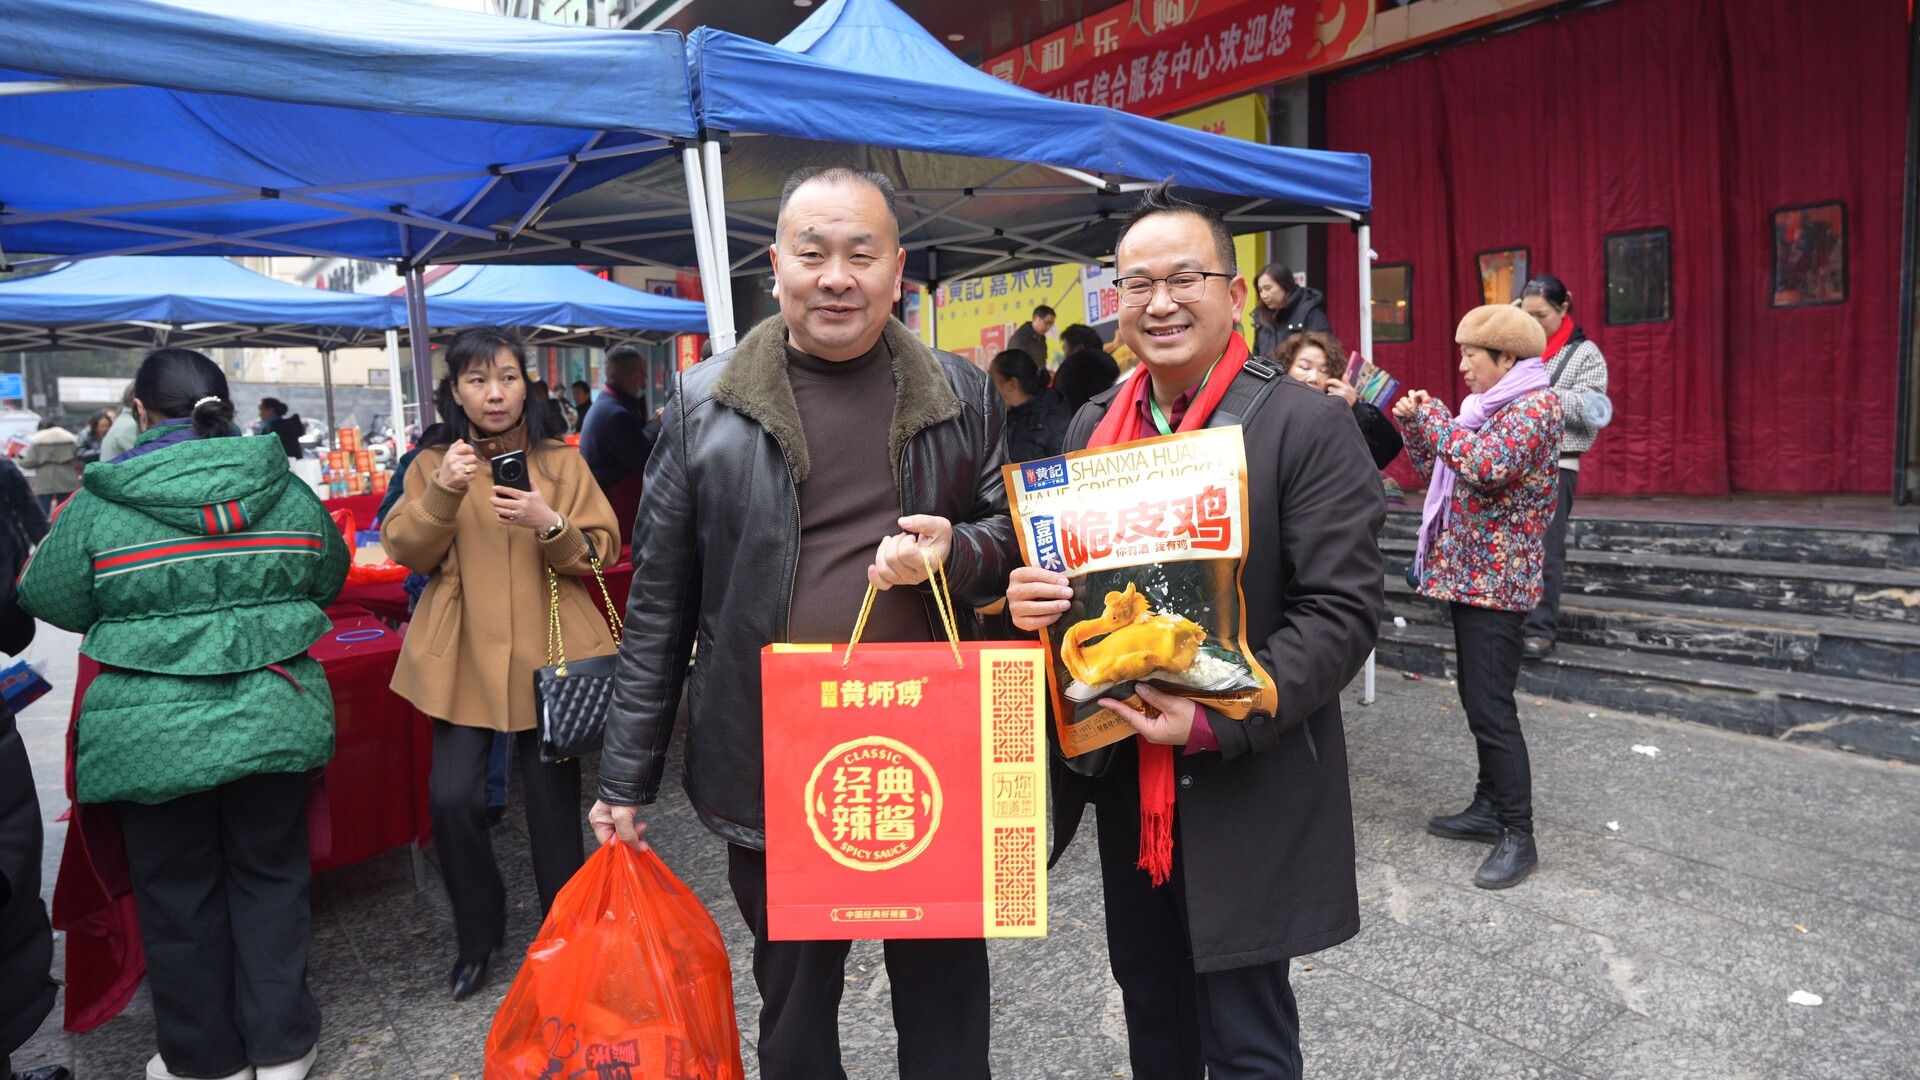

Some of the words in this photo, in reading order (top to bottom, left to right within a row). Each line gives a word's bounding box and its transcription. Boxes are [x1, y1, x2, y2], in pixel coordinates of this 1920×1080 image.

[1060, 484, 1231, 571] 脆皮鸡
[1154, 538, 1188, 553] 我有鸡
[840, 679, 923, 708] 黄师傅
[844, 748, 903, 765] CLASSIC
[832, 766, 915, 803] 经典
[996, 775, 1032, 799] 为您
[832, 805, 915, 842] 辣酱
[840, 842, 872, 859] SPICY
[873, 841, 909, 860] SAUCE
